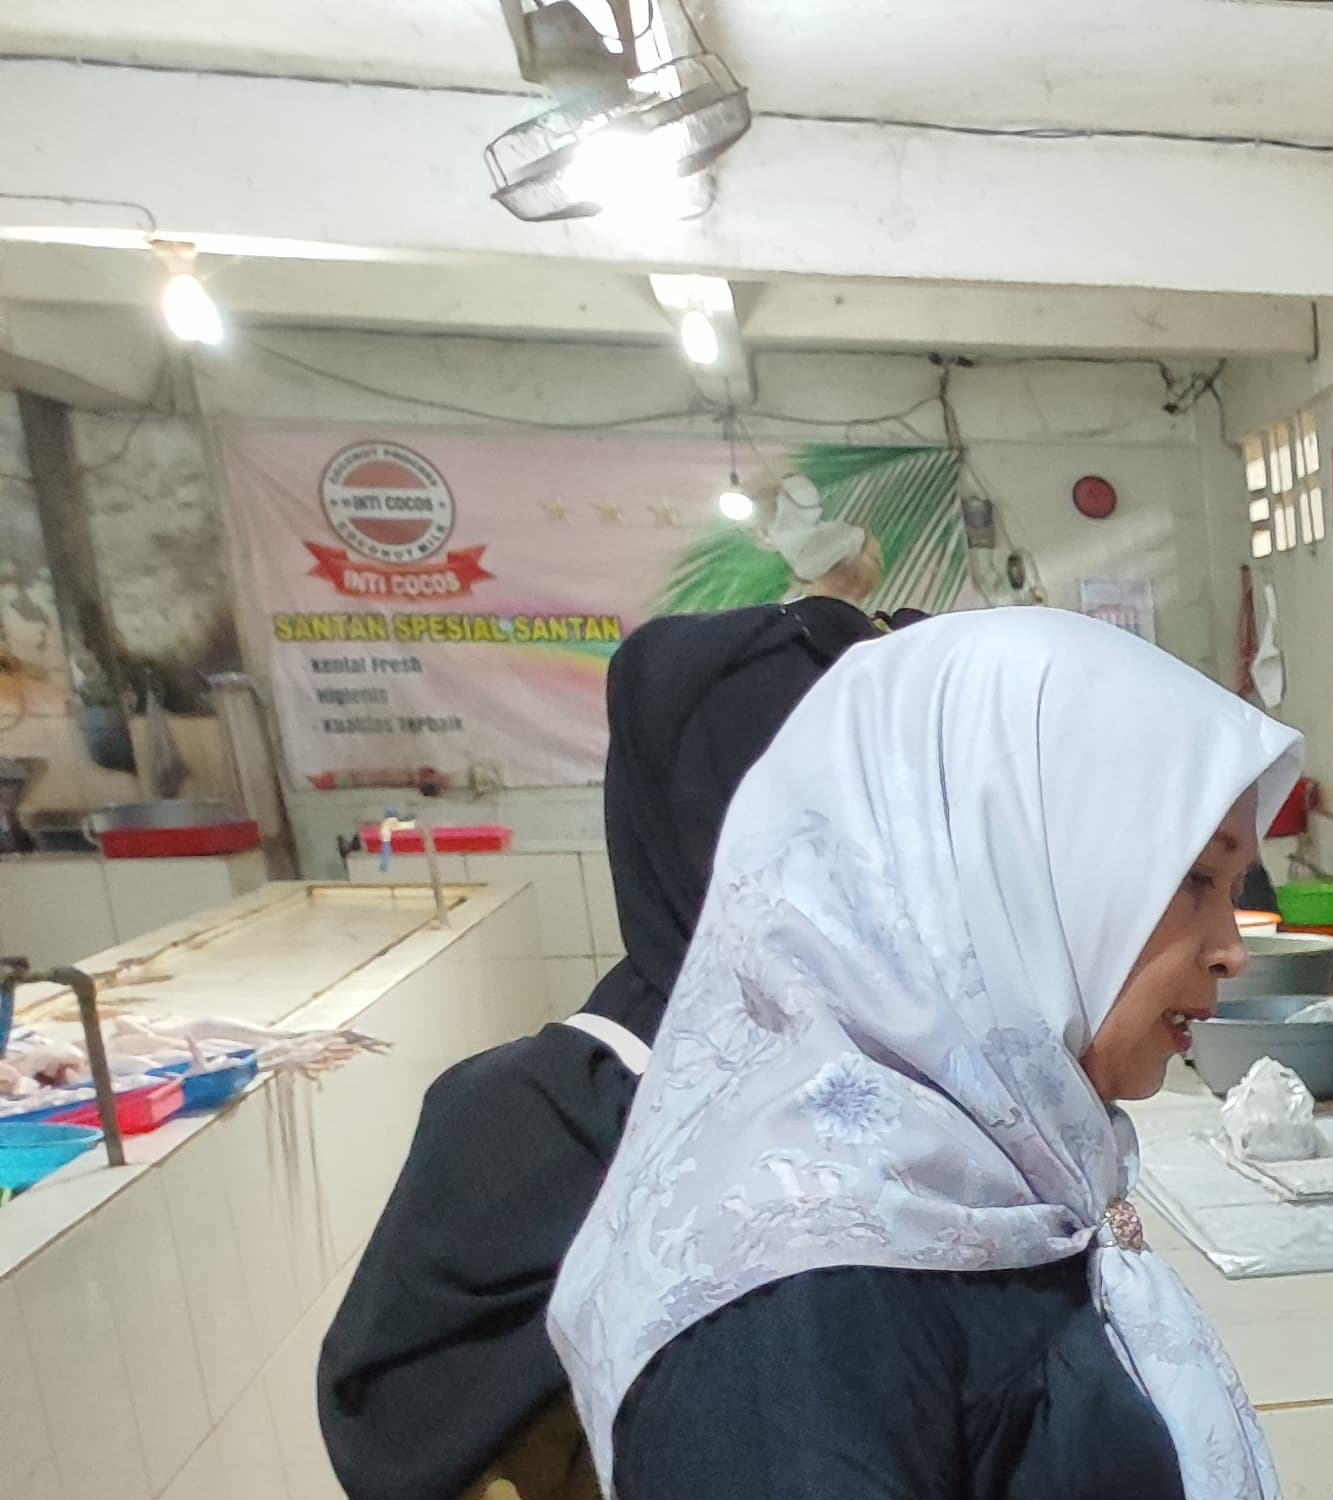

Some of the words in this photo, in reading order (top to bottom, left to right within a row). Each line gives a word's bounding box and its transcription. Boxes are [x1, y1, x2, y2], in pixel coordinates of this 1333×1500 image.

[352, 494, 383, 512] INTI
[384, 495, 434, 514] COCOS
[342, 568, 387, 595] INTI
[390, 569, 462, 597] COCOS
[273, 613, 390, 642] SANTAN
[393, 613, 510, 643] SPESIAL
[513, 613, 622, 643] SANTAN
[371, 655, 423, 674] Fresh
